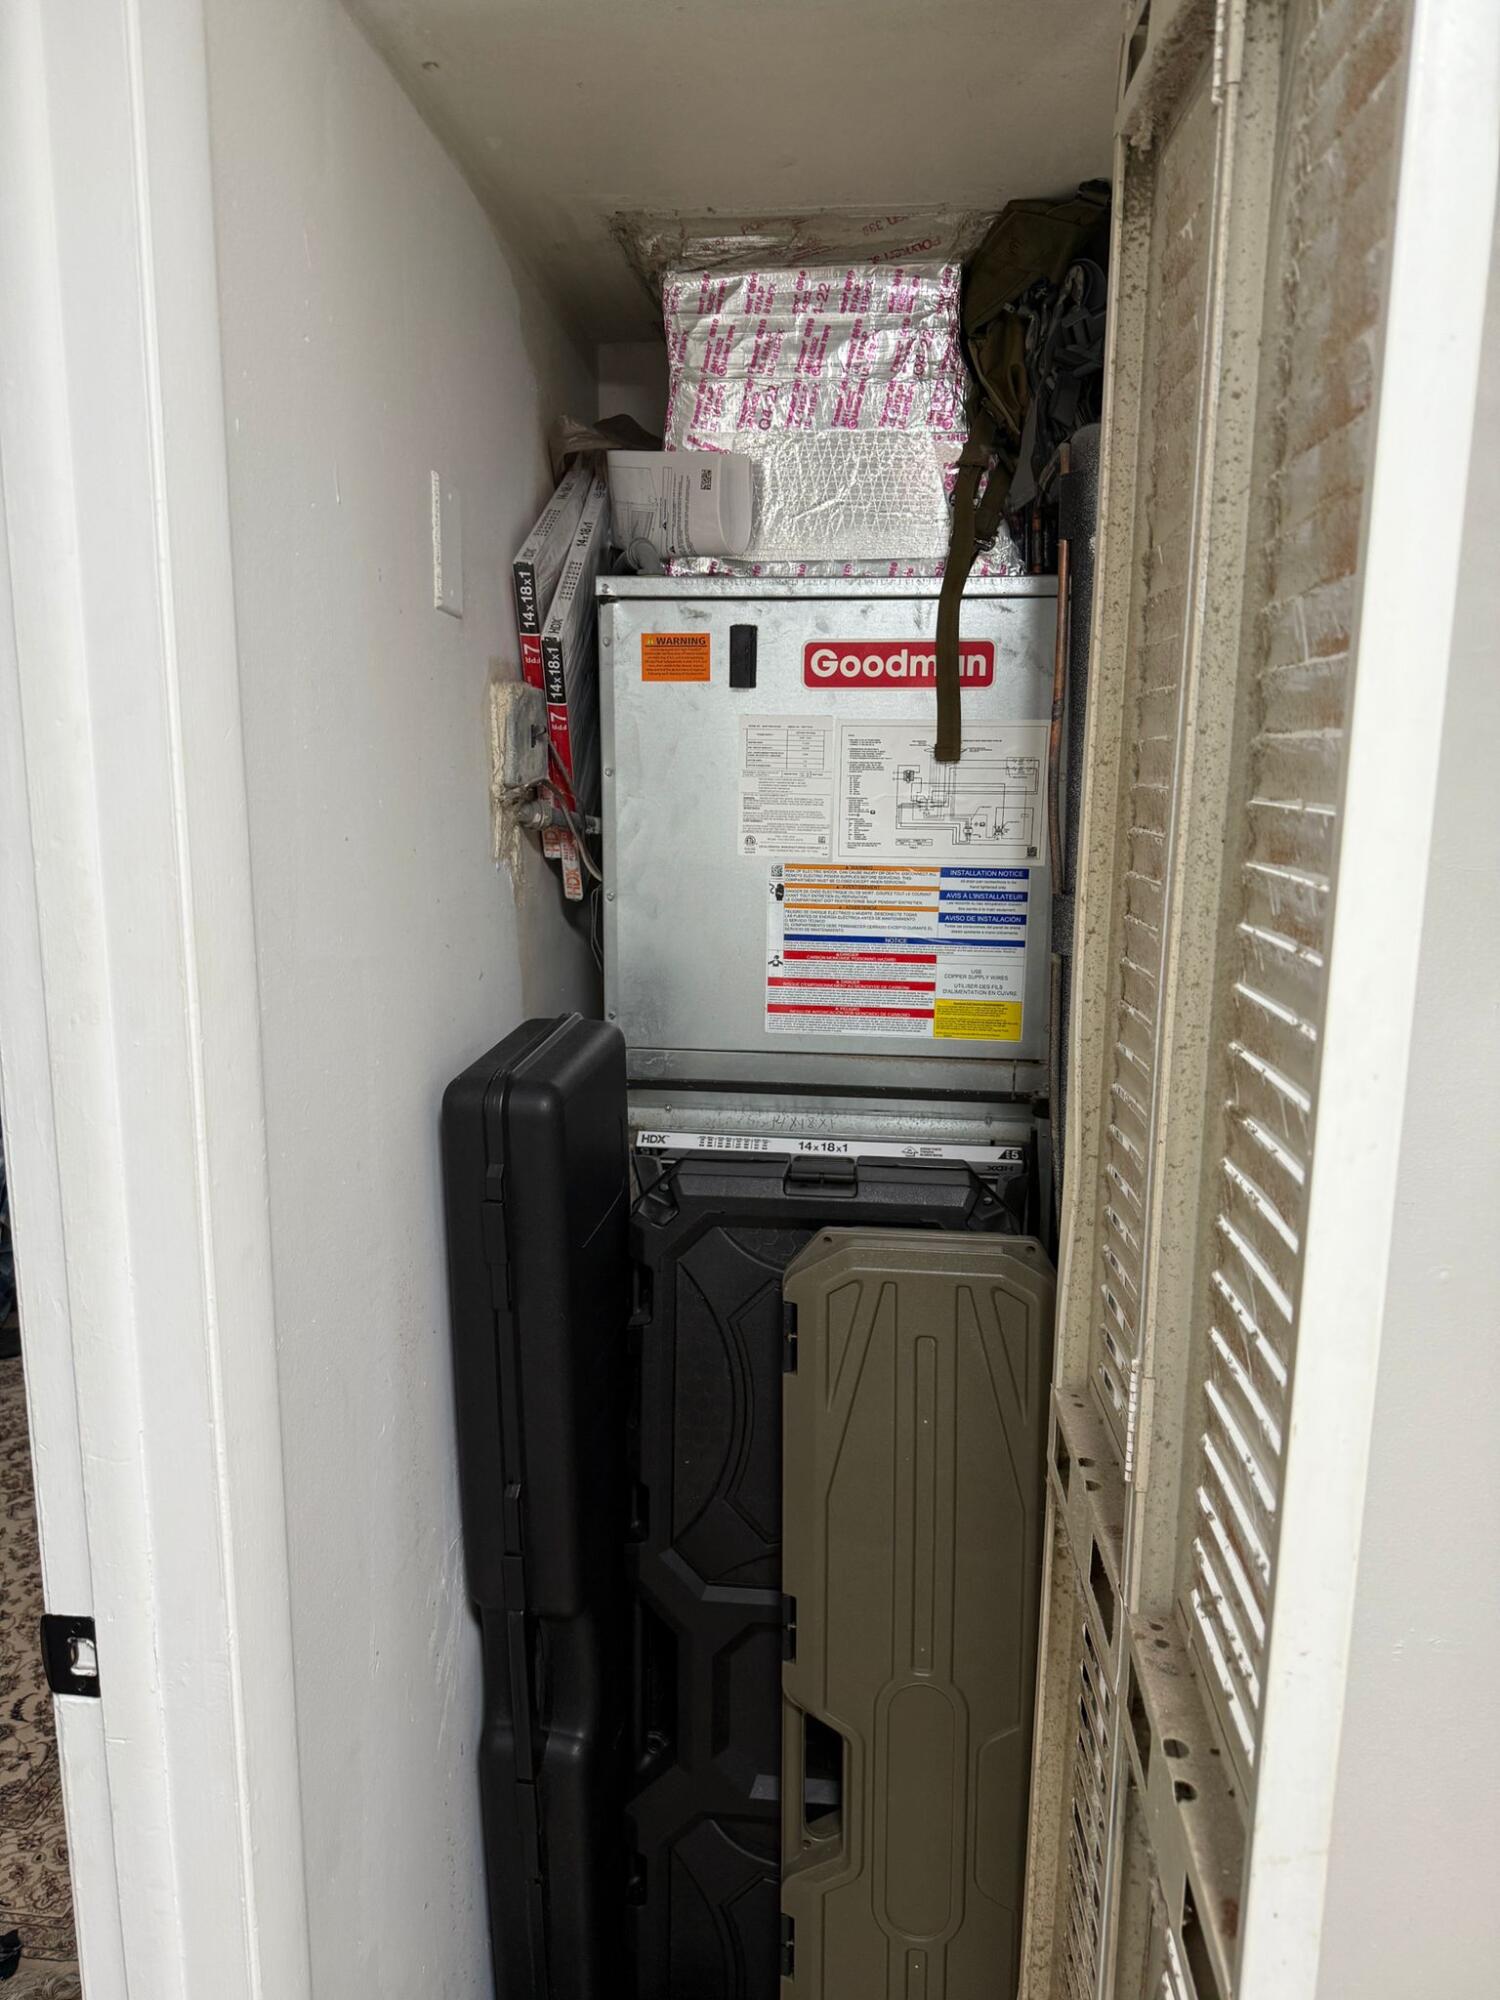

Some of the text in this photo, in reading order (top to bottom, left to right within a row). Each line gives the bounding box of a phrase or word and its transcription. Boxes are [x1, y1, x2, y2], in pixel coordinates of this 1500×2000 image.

[519, 571, 537, 629] 14x18x1
[656, 636, 706, 646] WARNING
[523, 644, 540, 655] 7
[547, 647, 563, 699] 14x18x1
[550, 711, 567, 723] 7
[950, 869, 1023, 878] INSTALLATION NOTICE
[566, 868, 582, 897] HDX
[946, 891, 961, 899] AVIS
[945, 914, 965, 922] AVISO
[798, 1141, 848, 1153] 14x18x1
[1011, 1150, 1019, 1159] 5
